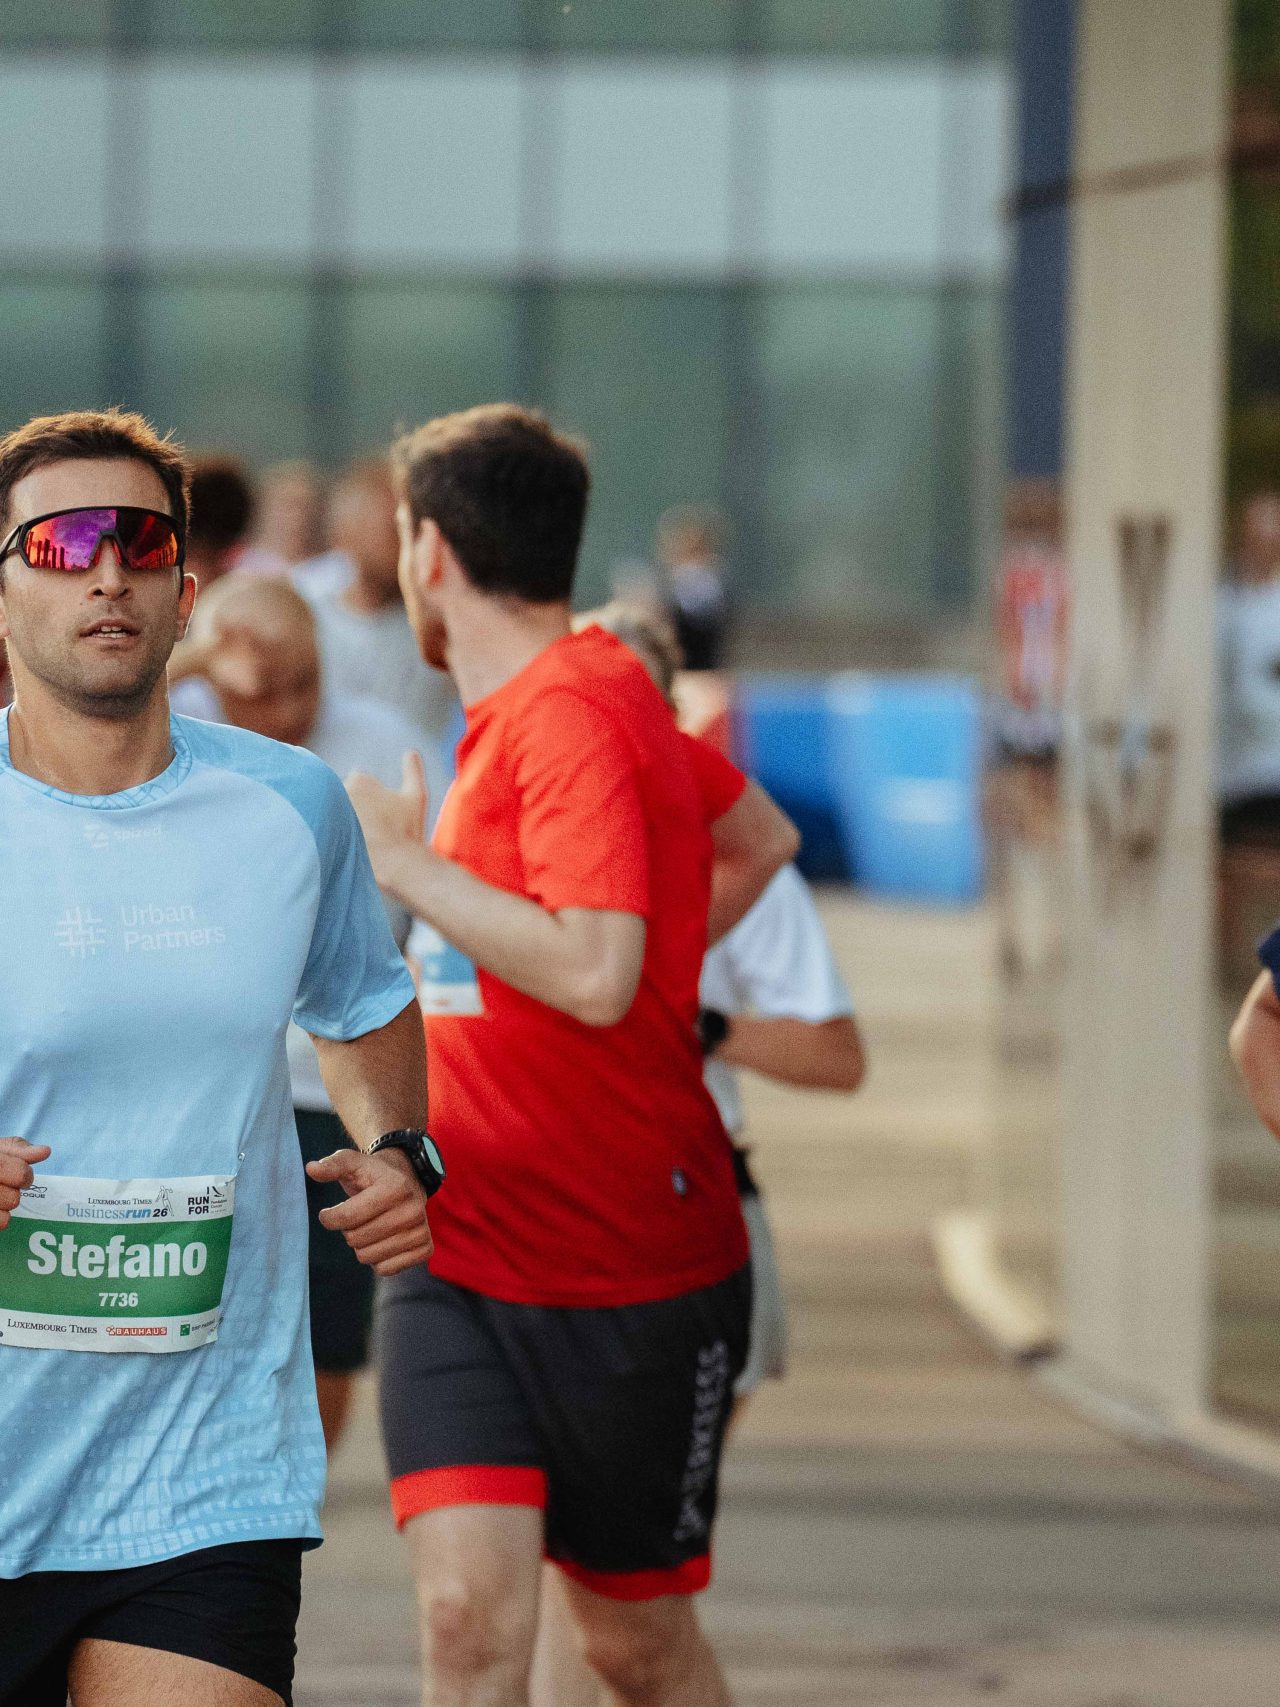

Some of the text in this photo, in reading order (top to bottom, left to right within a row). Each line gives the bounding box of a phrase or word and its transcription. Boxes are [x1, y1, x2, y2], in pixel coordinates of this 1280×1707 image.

[121, 903, 195, 927] Urban
[124, 926, 227, 952] Partners
[88, 1197, 153, 1206] LUXEMBOURG TIMES
[187, 1195, 210, 1206] RUN
[152, 1208, 168, 1218] 26
[188, 1205, 210, 1215] FOR
[27, 1230, 208, 1279] Stefano
[98, 1292, 139, 1308] 7736
[7, 1318, 98, 1334] LUXEMBOURG TIMES
[115, 1327, 168, 1336] BAUHAUS
